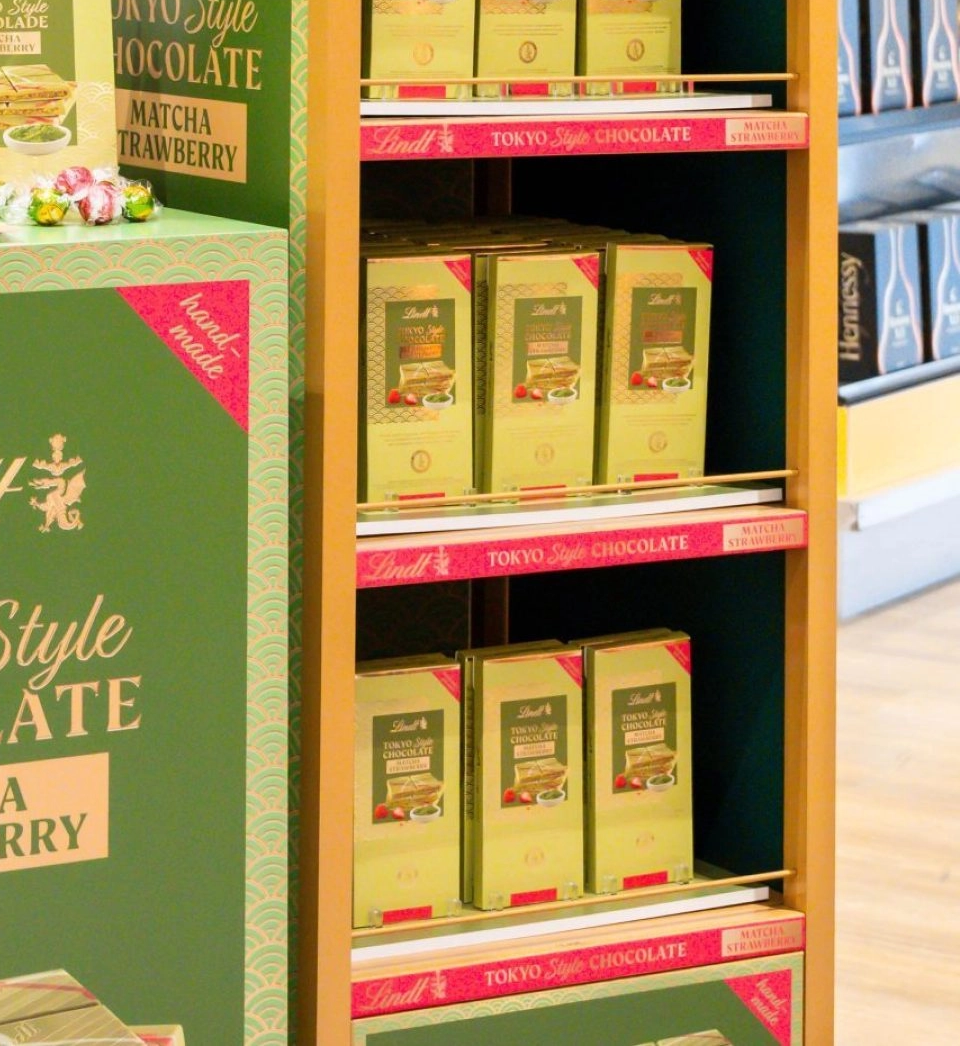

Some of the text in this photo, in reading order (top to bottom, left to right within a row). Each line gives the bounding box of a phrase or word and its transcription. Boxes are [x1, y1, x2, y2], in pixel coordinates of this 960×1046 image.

[113, 37, 263, 90] HOCOLATE
[130, 99, 212, 136] MATCHA
[743, 120, 788, 132] MATCHA
[368, 126, 691, 153] Lindt TOKYO Style CHOCOLATE
[730, 130, 800, 143] STRAWBERRY
[117, 130, 238, 172] TRAWBERRY
[839, 251, 863, 361] Hennessy
[169, 325, 224, 379] made
[742, 522, 786, 535] MATCHA
[728, 533, 798, 548] STRAWBERRY
[362, 534, 689, 580] Lindt TOKYO Style CHOCOLATE
[621, 718, 668, 731] CHOCOLATE
[383, 739, 413, 750] TOKYO
[511, 732, 558, 744] CHOCOLATE
[383, 746, 433, 760] CHOCOLATE
[741, 925, 786, 940] MATCHA
[727, 937, 798, 954] STRAWBERRY
[360, 941, 688, 1011] Lindt TOKYO Style CHOCOLATE
[750, 996, 779, 1025] made
